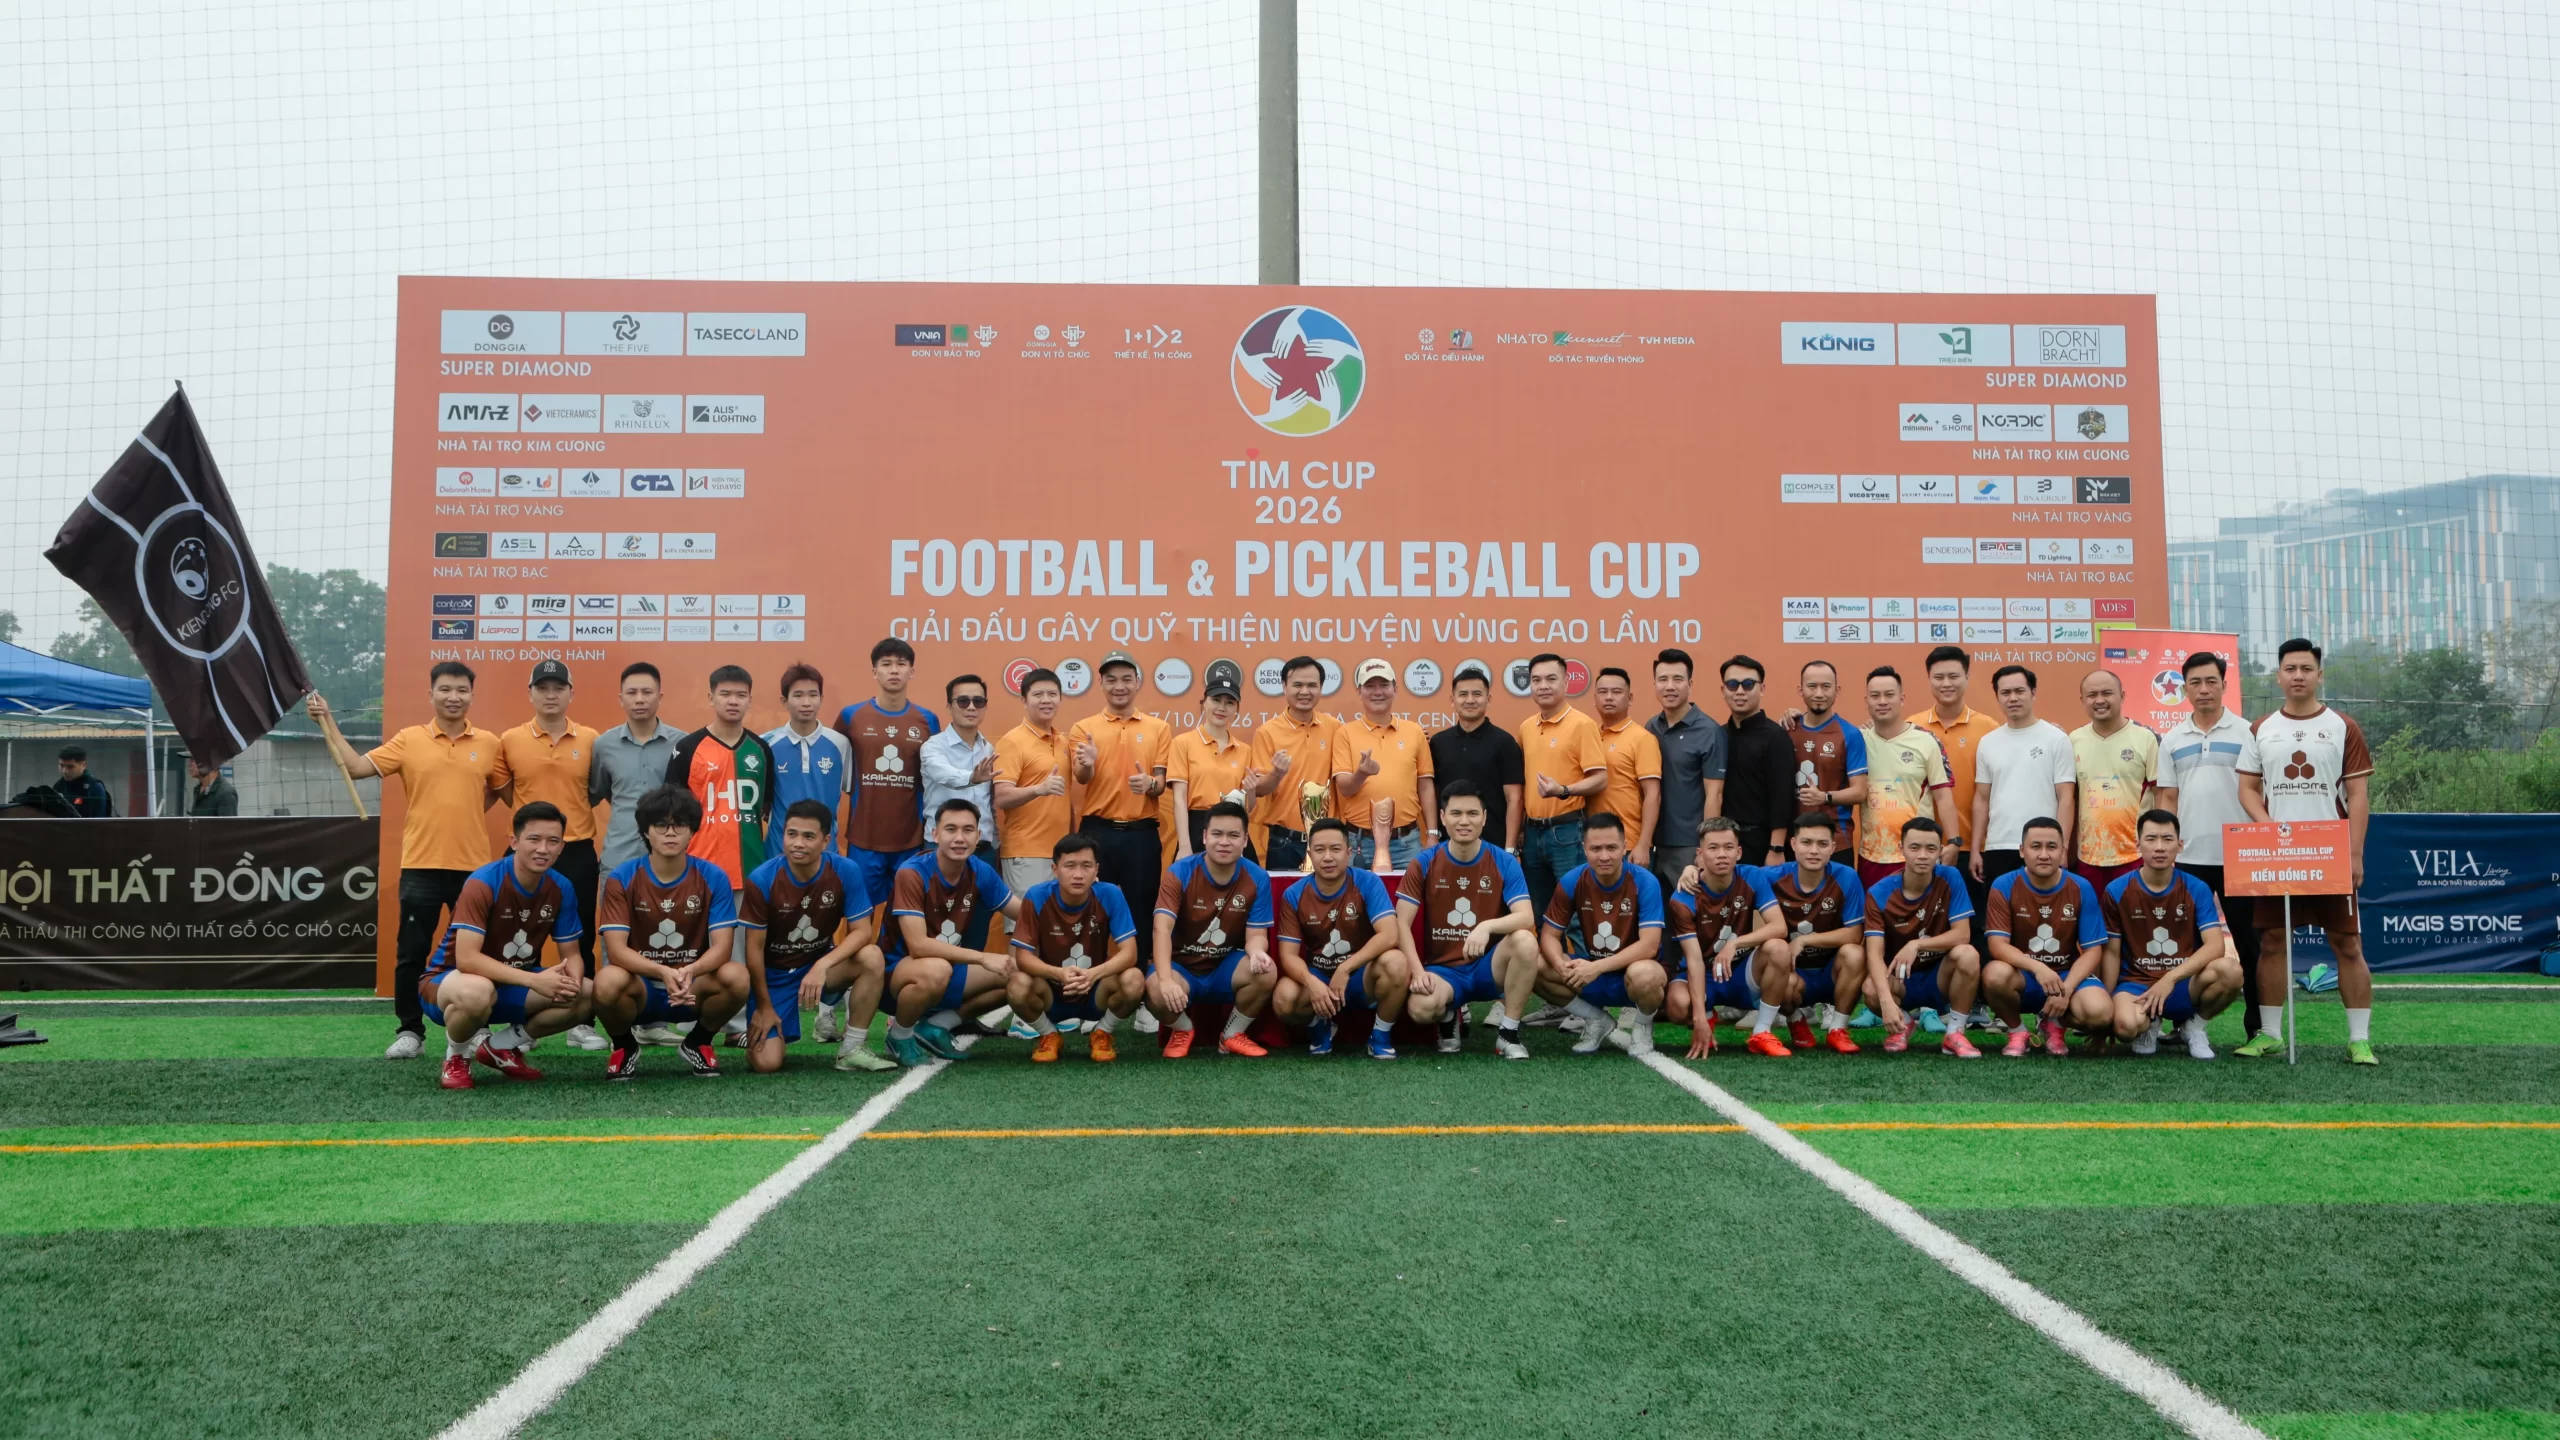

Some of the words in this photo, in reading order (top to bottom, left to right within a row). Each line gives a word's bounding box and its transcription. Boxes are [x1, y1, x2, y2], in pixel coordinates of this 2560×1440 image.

[694, 327, 799, 342] TASECOLAND
[1639, 337, 1661, 345] TVH
[1664, 337, 1695, 345] MEDIA
[2042, 330, 2097, 347] DORN
[474, 343, 527, 352] DONGGIA
[603, 344, 626, 353] THE
[628, 344, 650, 353] FIVE
[2042, 348, 2097, 361] BRACHT
[439, 360, 495, 377] SUPER
[502, 361, 592, 377] DIAMOND
[1985, 372, 2037, 388] SUPER
[2043, 373, 2127, 388] DIAMOND
[713, 405, 734, 415] ALIS
[614, 420, 670, 430] RHINELUX
[712, 414, 757, 424] LIGHTING
[437, 436, 468, 452] NHÀ
[471, 436, 493, 452] TÀI
[497, 438, 523, 455] TRỢ
[527, 440, 551, 452] KIM
[555, 438, 606, 453] CƯƠNG
[1973, 446, 2001, 461] NHÀ
[2004, 446, 2023, 461] TÀI
[2028, 448, 2052, 463] TRỢ
[2056, 450, 2079, 461] KIM
[2083, 448, 2130, 462] CƯƠNG
[1302, 461, 1375, 489] CUP
[439, 486, 470, 494] Deborah
[471, 486, 492, 494] Home
[435, 502, 465, 516] NHÀ
[470, 502, 489, 516] TÀI
[494, 503, 520, 518] TRỢ
[524, 502, 564, 516] VÀNG
[1255, 496, 1342, 524] 2026
[2012, 509, 2040, 523] NHÀ
[2044, 509, 2062, 523] TÀI
[2066, 511, 2091, 525] TRỢ
[2095, 509, 2132, 523] VÀNG
[554, 549, 595, 557] ARITCO
[1925, 546, 1972, 555] SENDESIGN
[433, 563, 463, 577] NHÀ
[468, 563, 487, 577] TÀI
[492, 565, 518, 579] TRỢ
[522, 566, 548, 580] BẠC
[890, 538, 1168, 597] FOOTBALL
[1187, 559, 1215, 597] &
[1235, 540, 1571, 598] PICKLEBALL
[1589, 541, 1700, 599] CUP
[2027, 568, 2055, 582] NHÀ
[2058, 568, 2077, 582] TÀI
[2081, 570, 2106, 584] TRỢ
[2110, 571, 2134, 585] BẠC
[219, 580, 240, 600] FC
[532, 597, 566, 608] mira
[2099, 603, 2128, 612] ADES
[438, 626, 464, 635] Dulux
[575, 626, 613, 635] MARCH
[890, 609, 950, 642] GIẢI
[960, 607, 1027, 642] ĐẤU
[1038, 612, 1100, 642] GÂY
[1110, 611, 1177, 646] QUỸ
[1187, 611, 1280, 648] THIỆN
[1292, 612, 1421, 648] NGUYỆN
[1432, 612, 1518, 643] VÙNG
[1528, 618, 1589, 643] CAO
[1600, 609, 1659, 643] LẦN
[1668, 618, 1701, 643] 10
[431, 646, 460, 660] NHÀ
[465, 646, 485, 660] TÀI
[489, 648, 515, 662] TRỢ
[519, 646, 562, 661] ĐỒNG
[566, 646, 605, 661] HÀNH
[1974, 648, 2002, 662] NHÀ
[2006, 648, 2025, 662] TÀI
[2029, 650, 2053, 664] TRỢ
[2056, 648, 2096, 663] ĐỒNG
[862, 773, 914, 783] KAIHOME
[2272, 782, 2329, 791] KAIHOME
[707, 779, 759, 812] HD
[2239, 849, 2271, 857] FOOTBALL
[2277, 847, 2318, 856] PICKLEBALL
[2319, 847, 2334, 855] CUP
[2410, 850, 2482, 876] VELA
[69, 854, 175, 903] THẤT
[190, 851, 325, 903] ĐỒNG
[342, 866, 379, 901] G
[2251, 867, 2276, 882] KIẾN
[2310, 869, 2324, 881] FC
[17, 921, 58, 939] THẦU
[64, 925, 86, 939] THI
[96, 922, 145, 939] CÔNG
[151, 922, 180, 941] NỘI
[186, 920, 225, 938] THẤT
[229, 919, 257, 938] GỖ
[264, 920, 290, 938] ÓC
[295, 919, 333, 938] CHÓ
[338, 922, 377, 937] CAO
[2383, 915, 2445, 932] MAGIS
[2450, 915, 2523, 932] STONE
[1432, 928, 1471, 937] KAIHO
[2293, 937, 2324, 945] IVING
[2383, 934, 2428, 947] Luxury
[2434, 934, 2479, 944] Quartz
[2486, 934, 2524, 944] Stone
